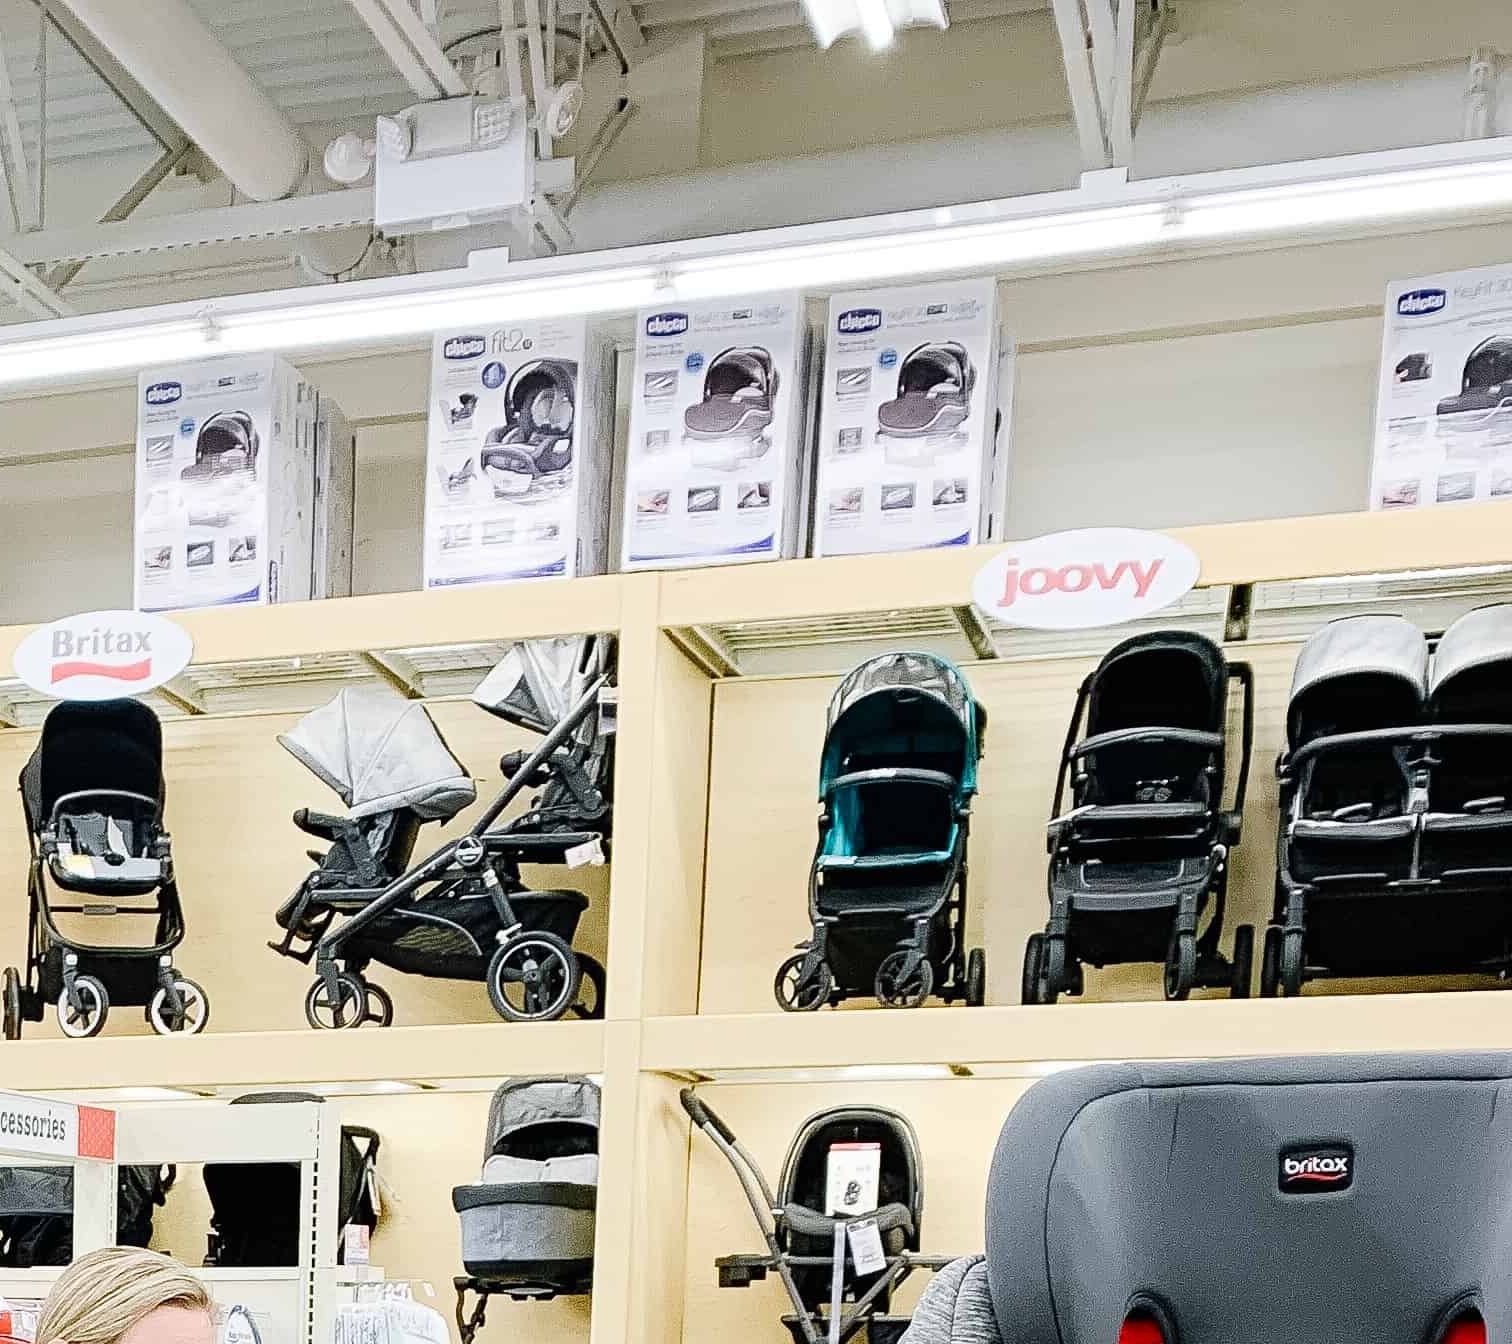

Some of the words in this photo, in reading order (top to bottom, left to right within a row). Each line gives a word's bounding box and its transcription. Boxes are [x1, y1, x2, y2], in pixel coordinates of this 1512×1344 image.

[997, 557, 1164, 607] joovy
[51, 626, 152, 659] Britax
[1285, 1156, 1348, 1175] britax
